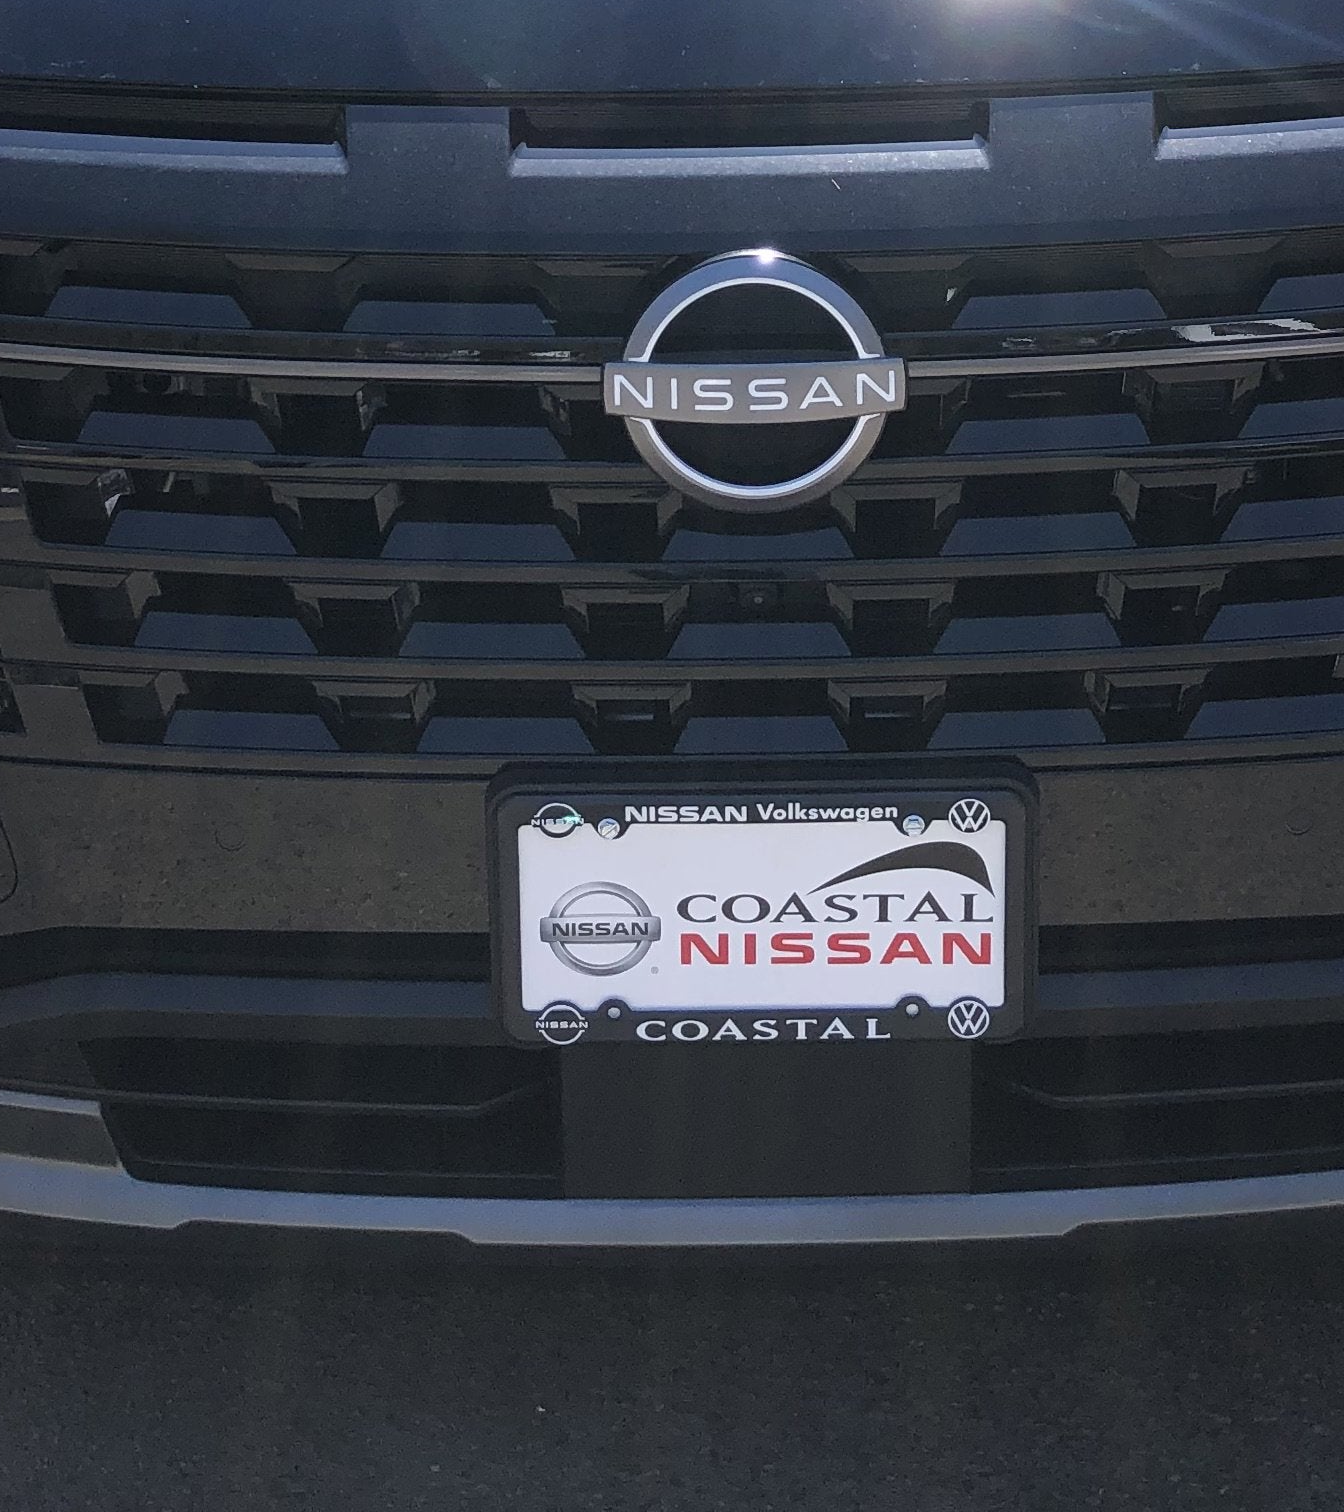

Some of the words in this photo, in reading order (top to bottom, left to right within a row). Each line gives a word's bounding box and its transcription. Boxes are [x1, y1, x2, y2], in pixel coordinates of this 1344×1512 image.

[613, 370, 895, 411] NISSAN
[624, 805, 748, 823] NISSAN
[756, 802, 898, 822] Volkswagen
[676, 891, 994, 924] COASTAL
[552, 922, 649, 937] NISSAN
[680, 933, 991, 965] NISSAN
[535, 1019, 588, 1030] NISSAN
[636, 1018, 891, 1041] COASTAL
